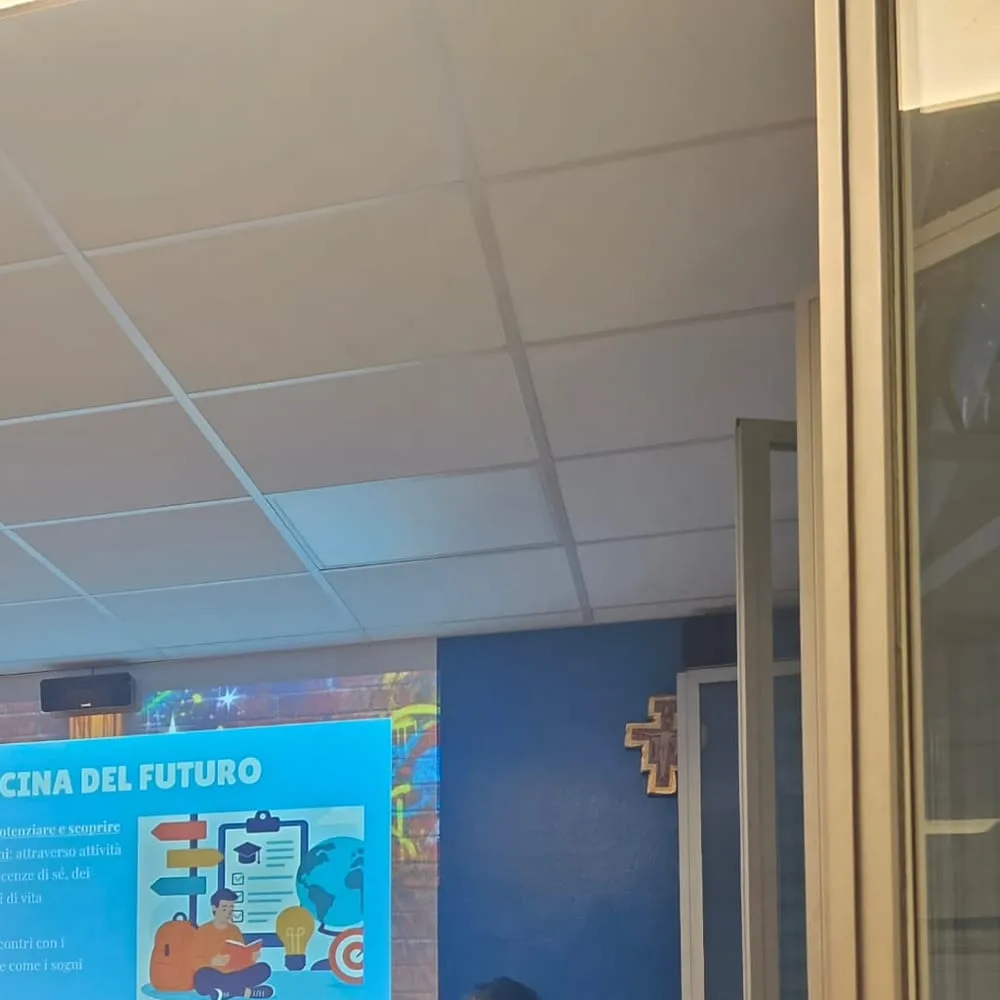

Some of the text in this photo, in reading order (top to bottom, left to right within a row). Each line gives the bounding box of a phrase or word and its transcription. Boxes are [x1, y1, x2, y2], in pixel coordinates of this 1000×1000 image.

[81, 766, 131, 793] DEL
[139, 757, 262, 790] FUTURO
[58, 826, 66, 836] e
[67, 820, 120, 836] scoprire
[15, 847, 76, 860] attraverso
[78, 842, 121, 857] attività
[37, 867, 49, 881] di
[71, 866, 91, 880] dei
[6, 891, 18, 904] di
[20, 891, 42, 904] vita
[36, 939, 58, 950] con
[8, 962, 41, 972] come
[50, 957, 83, 974] sogni
